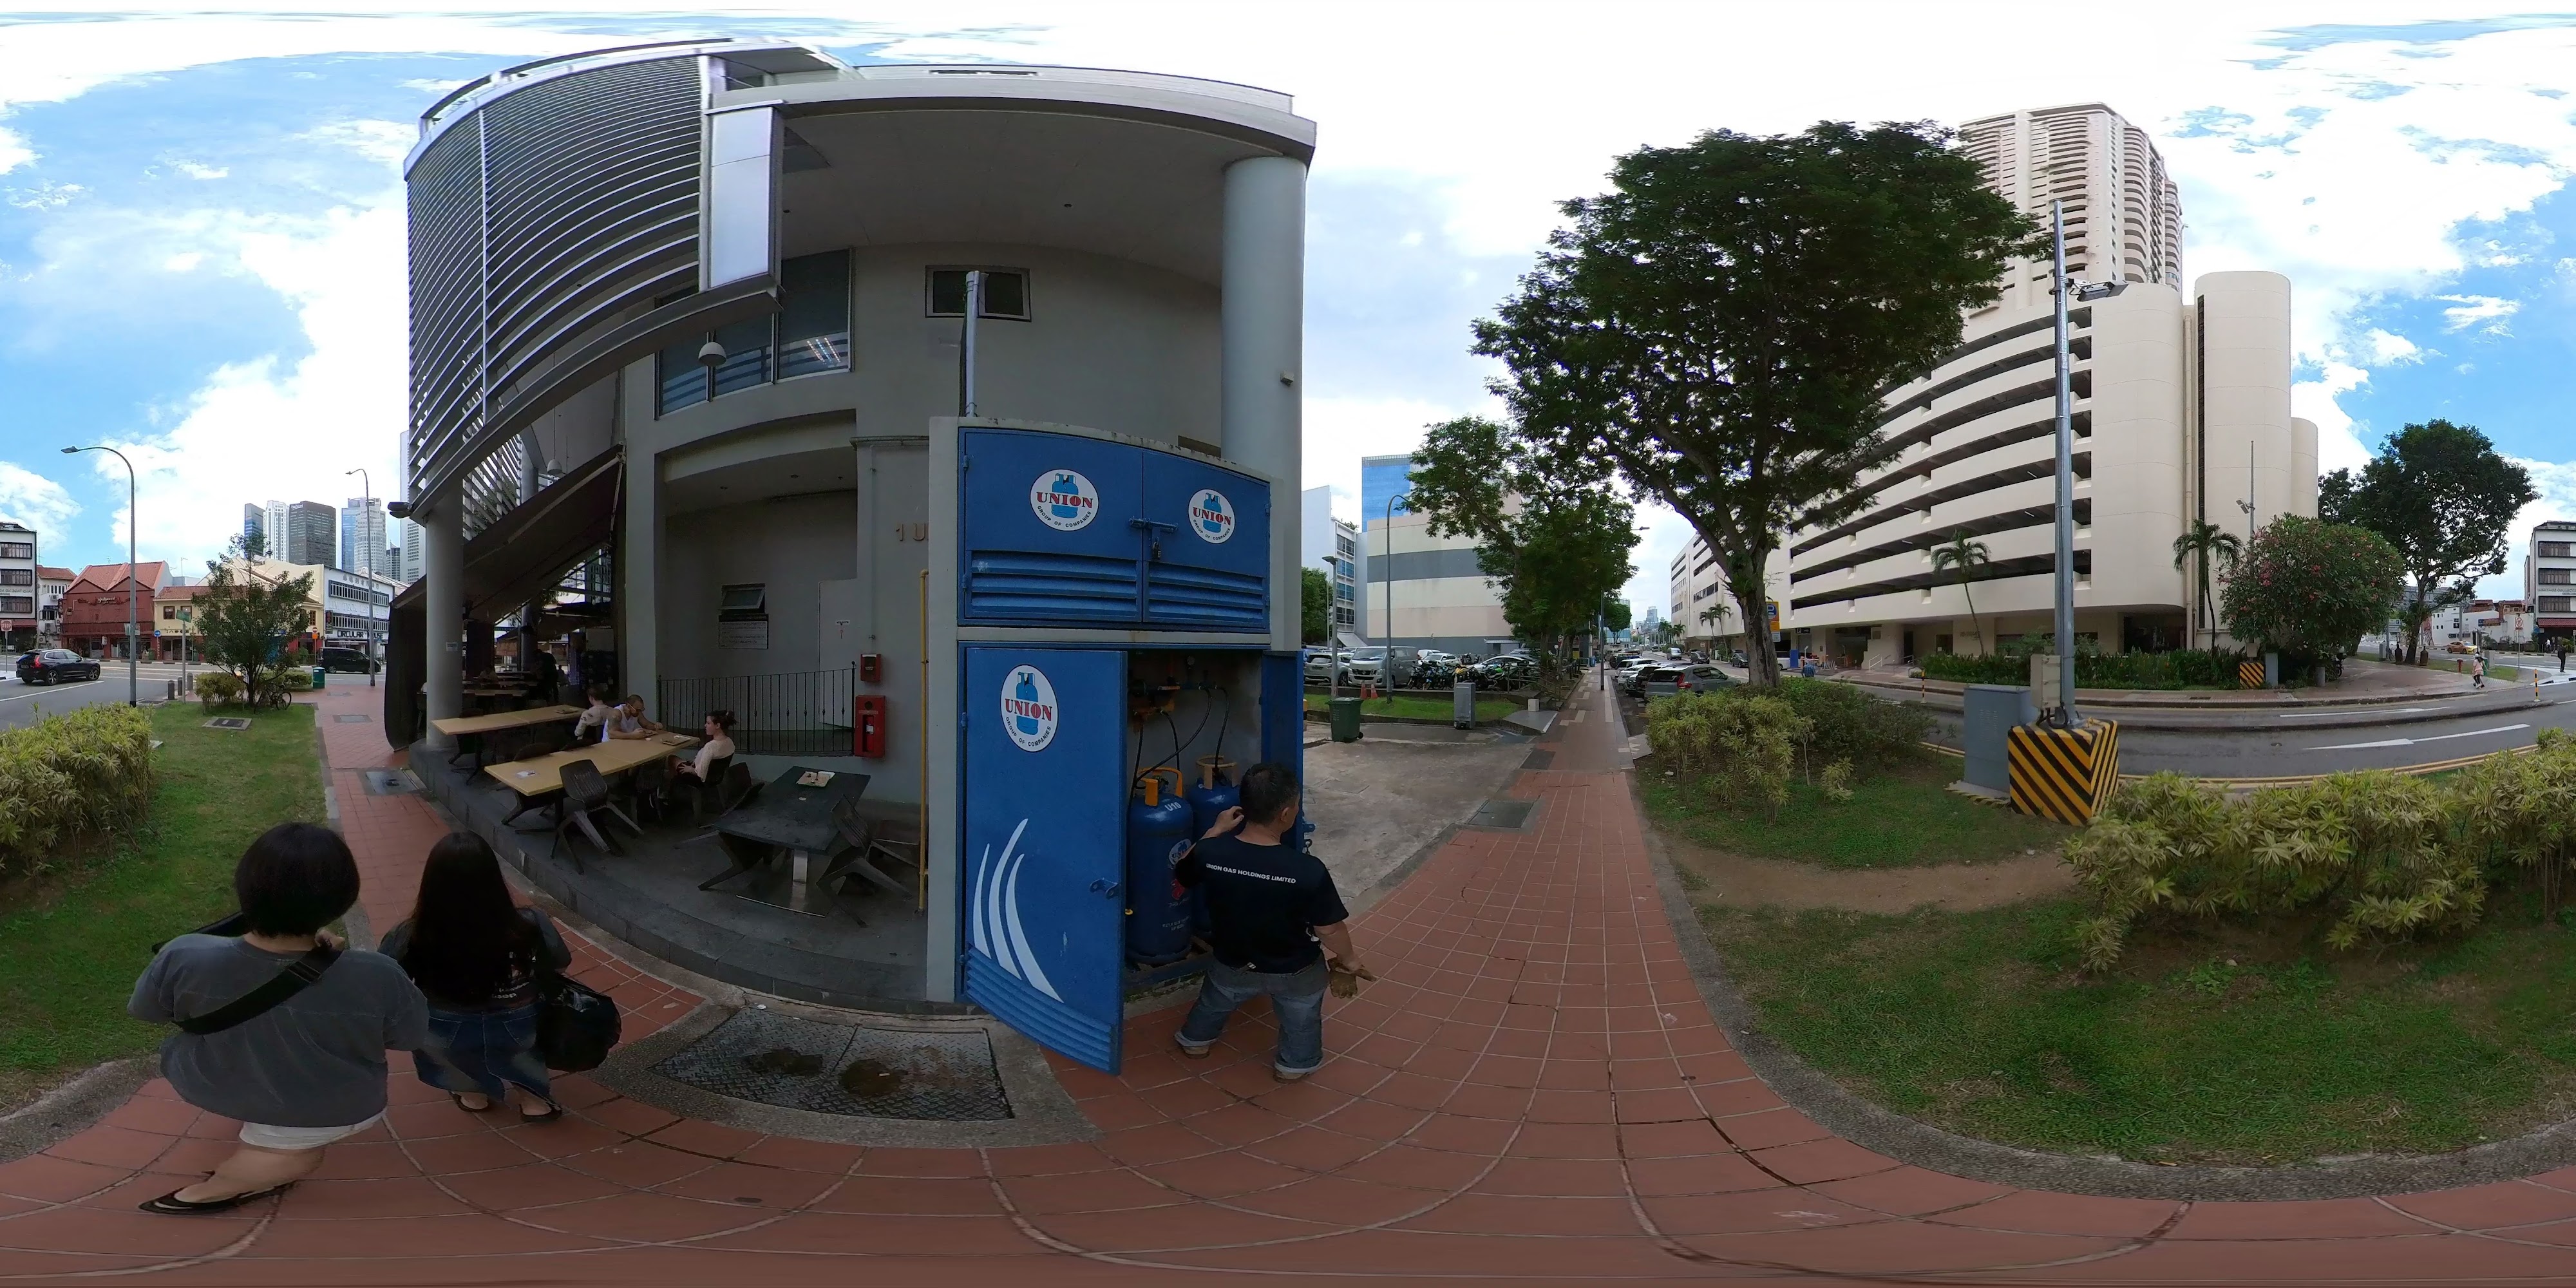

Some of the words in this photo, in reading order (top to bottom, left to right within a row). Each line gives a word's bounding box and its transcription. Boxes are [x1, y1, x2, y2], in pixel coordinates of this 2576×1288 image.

[1036, 492, 1094, 508] UNION
[1037, 506, 1051, 521] GROUP
[1065, 511, 1092, 527] COMPANIES
[1193, 506, 1231, 526] UNION
[1193, 520, 1203, 533] GROUP
[1213, 528, 1231, 540] COMPANIES
[1005, 699, 1052, 721] UNION
[1006, 717, 1017, 736] GROUP
[1028, 725, 1051, 746] COMPANIES
[1164, 802, 1182, 811] U10
[1238, 869, 1271, 880] HOLDINGS
[1271, 875, 1296, 884] LIMITED
